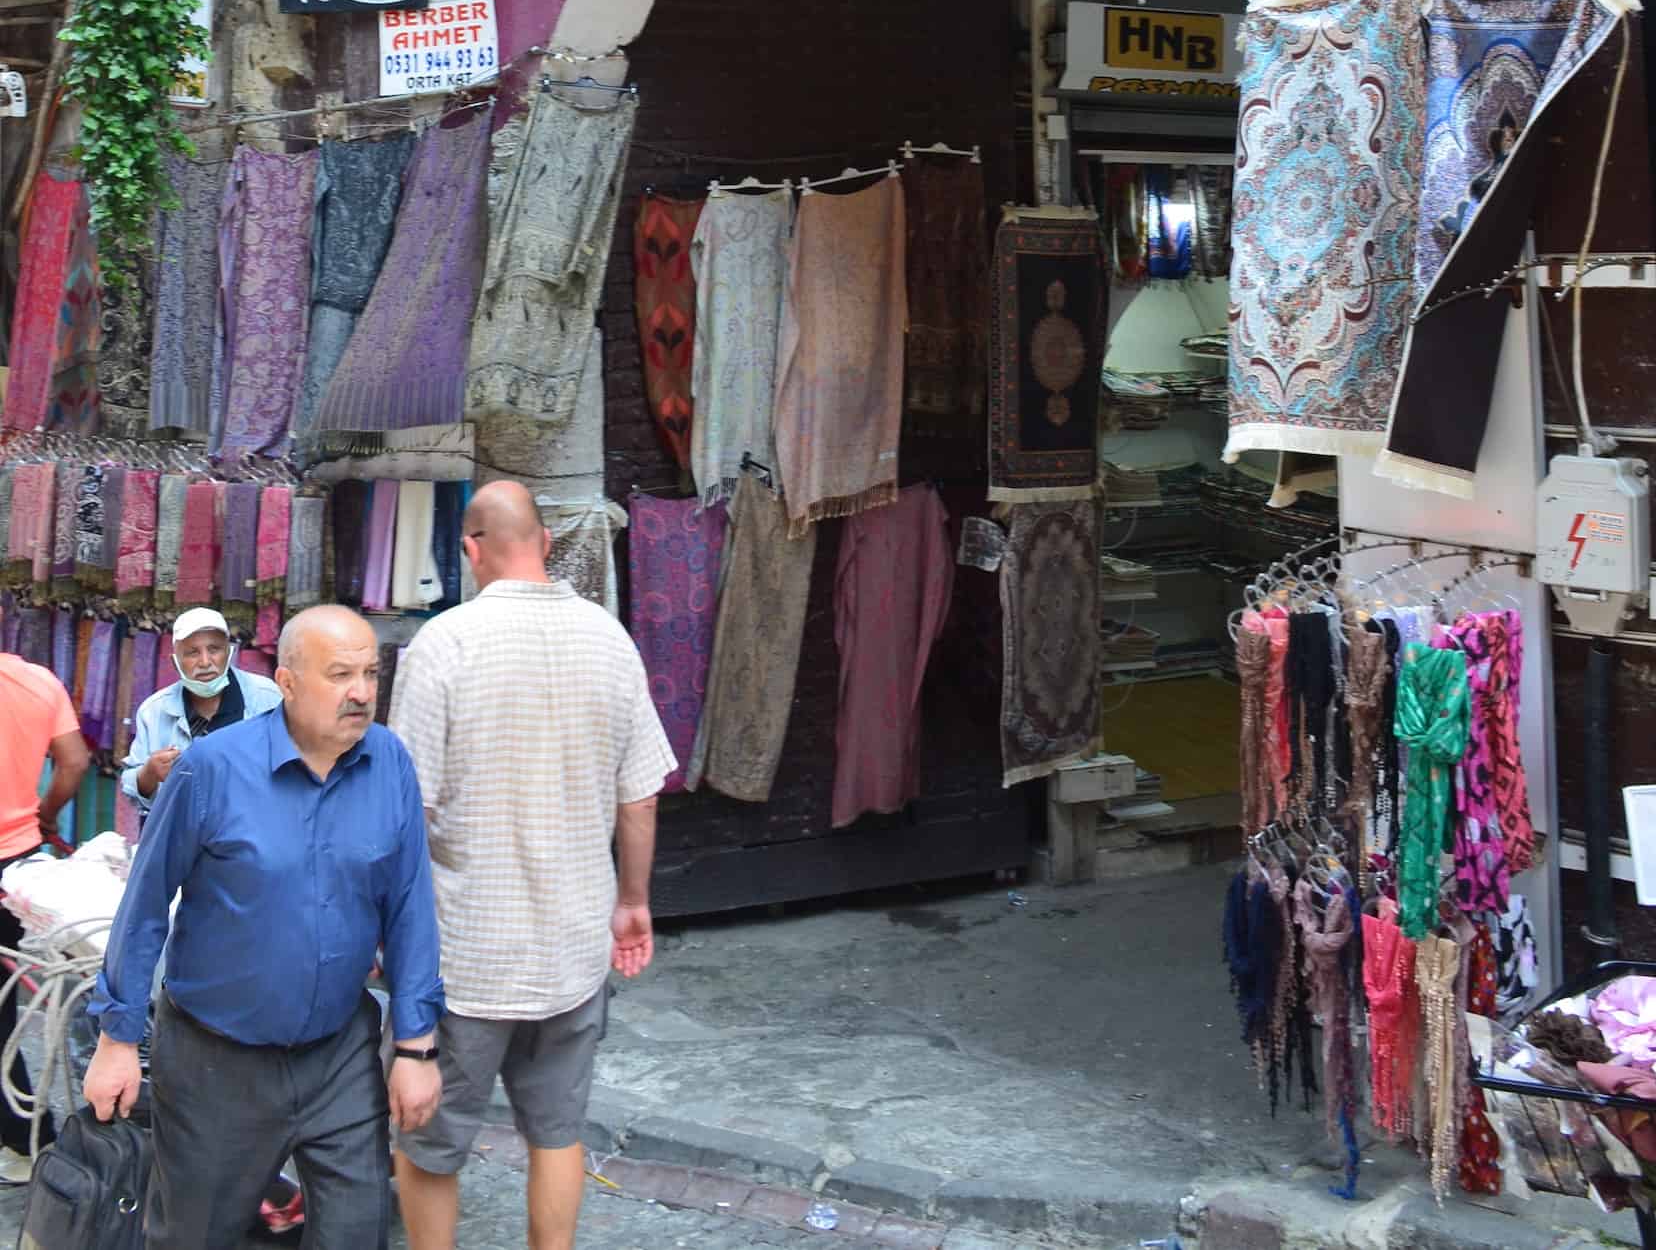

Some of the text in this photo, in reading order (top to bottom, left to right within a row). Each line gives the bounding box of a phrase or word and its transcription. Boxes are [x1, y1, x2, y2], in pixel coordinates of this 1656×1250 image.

[384, 2, 489, 27] BERBER
[392, 25, 482, 50] AHMET
[1119, 15, 1216, 70] HNB
[385, 53, 418, 75] 0531
[457, 48, 473, 69] 93
[406, 72, 473, 89] ORTA KAT
